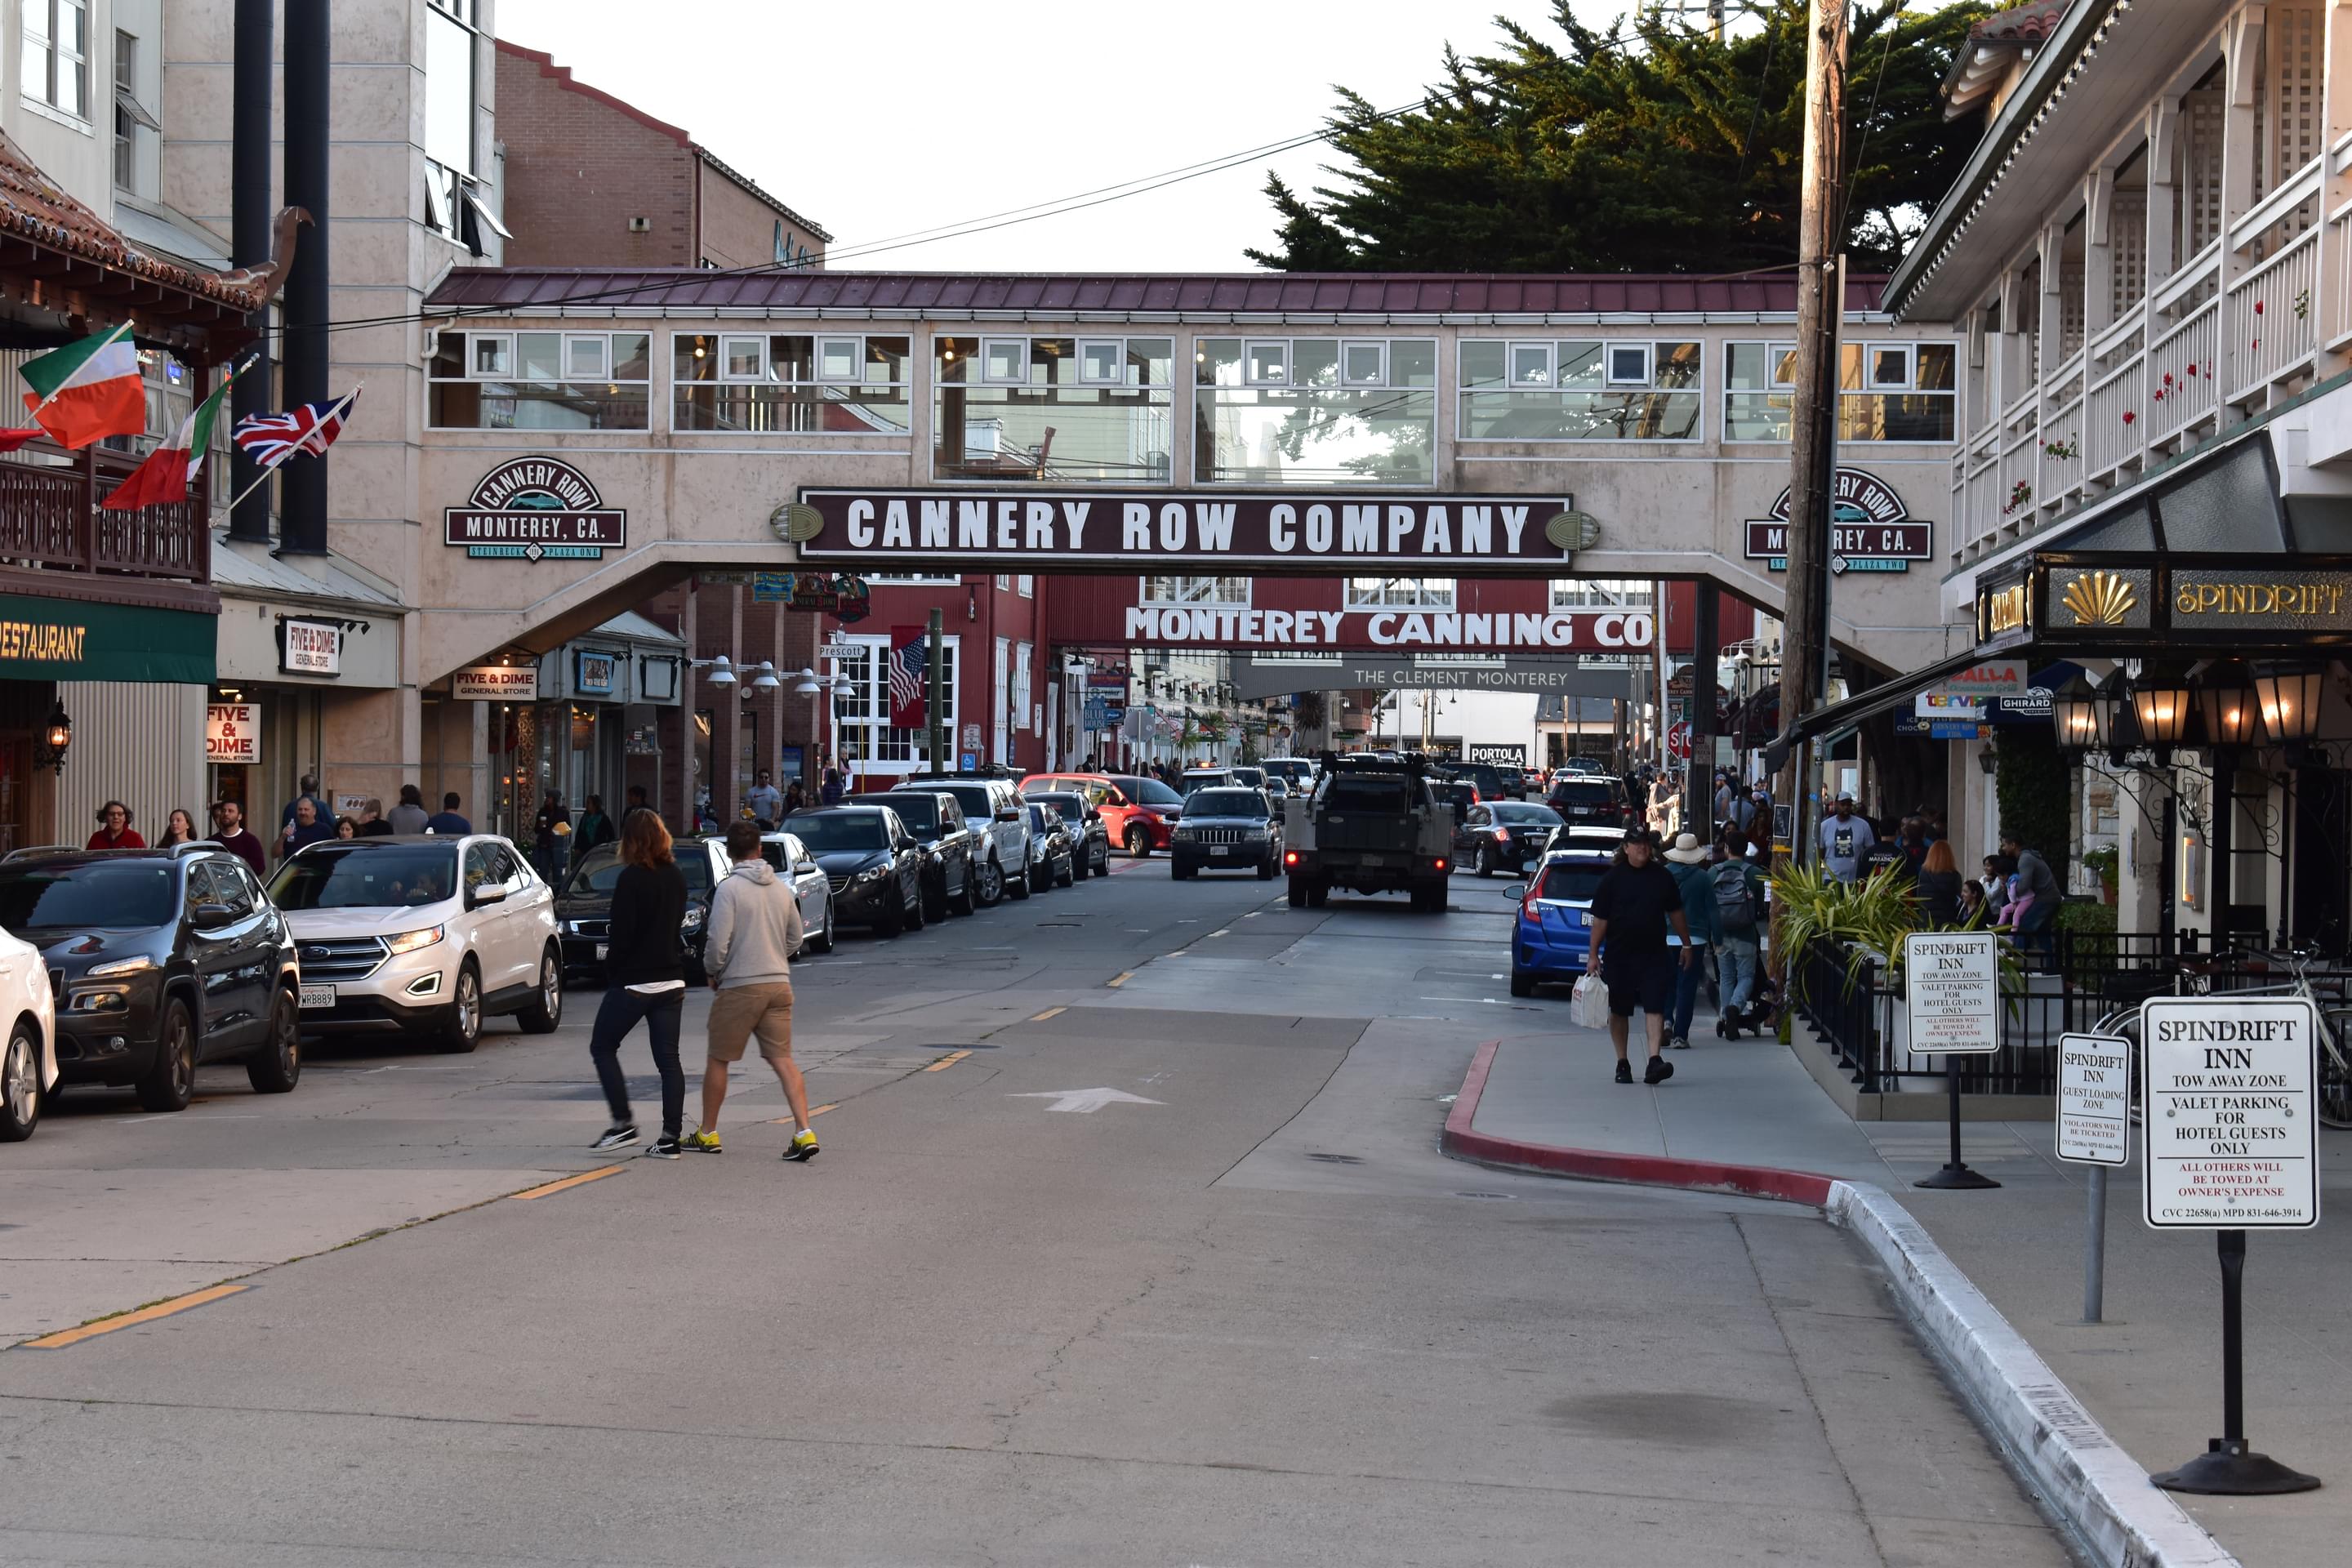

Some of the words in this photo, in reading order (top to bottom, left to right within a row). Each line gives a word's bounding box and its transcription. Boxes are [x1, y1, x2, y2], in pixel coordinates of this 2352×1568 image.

[482, 465, 556, 506] CANNERY
[555, 473, 591, 508] ROW
[1860, 483, 1897, 519] ROW
[466, 516, 568, 540] MONTEREY,
[577, 518, 605, 538] CA.
[849, 499, 1089, 549] CANNERY
[1122, 502, 1236, 551] ROW
[1268, 504, 1529, 555] COMPANY
[1767, 528, 1872, 553] MREY,
[1882, 530, 1911, 550] CA.
[549, 548, 576, 557] PLAZA
[580, 548, 598, 557] ONE
[1853, 561, 1880, 569] PLAZA
[1886, 561, 1904, 569] TWO
[2176, 583, 2343, 614] SPINDRIFT
[1126, 607, 1346, 644] MONTEREY
[1368, 612, 1573, 646] CANNING
[1594, 614, 1652, 646] CO
[0, 622, 85, 661] ESTAURANT
[291, 626, 308, 651] FIVE
[310, 629, 315, 652] &
[316, 630, 336, 654] DIME
[820, 646, 861, 656] Prescott
[457, 674, 486, 684] FIVE
[489, 674, 498, 684] &
[501, 674, 533, 684] DIME
[1354, 670, 1385, 684] THE
[1392, 670, 1470, 684] CLEMENT
[1477, 672, 1568, 686] MONTEREY
[1996, 684, 2018, 693] Grill
[2003, 699, 2050, 707] GHIRARD
[207, 706, 250, 721] FIVE
[222, 722, 236, 737] &
[207, 737, 253, 753] DIME
[1472, 748, 1524, 763] PORTOLA
[1914, 943, 1987, 956] SPINDRIFT
[1938, 958, 1963, 969] INN
[1924, 999, 1950, 1007] HOTEL
[2158, 1020, 2297, 1041] SPINDRIFT
[2065, 1053, 2123, 1069] SPINDRIFT
[2203, 1049, 2252, 1069] INN
[2083, 1070, 2104, 1083] INN
[2172, 1075, 2205, 1087] TOW
[2208, 1075, 2246, 1087] AWAY
[2249, 1075, 2287, 1087] ZONE
[2063, 1086, 2087, 1098] GUEST
[2089, 1089, 2124, 1101] LOADING
[2082, 1099, 2105, 1110] ZONE
[2172, 1097, 2218, 1109] VALET
[2223, 1096, 2288, 1109] PARKING
[2215, 1111, 2246, 1125] FOR
[2064, 1120, 2103, 1129] VIOLATORS
[2104, 1123, 2122, 1131] WILL
[2080, 1129, 2115, 1138] TICKETED
[2176, 1127, 2226, 1140] HOTEL
[2230, 1126, 2286, 1139] GUESTS
[2210, 1143, 2251, 1155] ONLY
[2179, 1163, 2202, 1172] ALL
[2204, 1162, 2251, 1172] OTHERS
[2252, 1163, 2283, 1172] WILL
[2193, 1175, 2207, 1184] BE
[2210, 1175, 2252, 1184] TOWED
[2256, 1175, 2270, 1184] AT
[2178, 1187, 2230, 1196] OWNER'S
[2234, 1187, 2284, 1196] EXPENSE
[2162, 1208, 2183, 1217] CVC
[2185, 1208, 2221, 1218] 22658(a)
[2223, 1208, 2244, 1217] MPD
[2247, 1208, 2301, 1217] 831-646-3914
